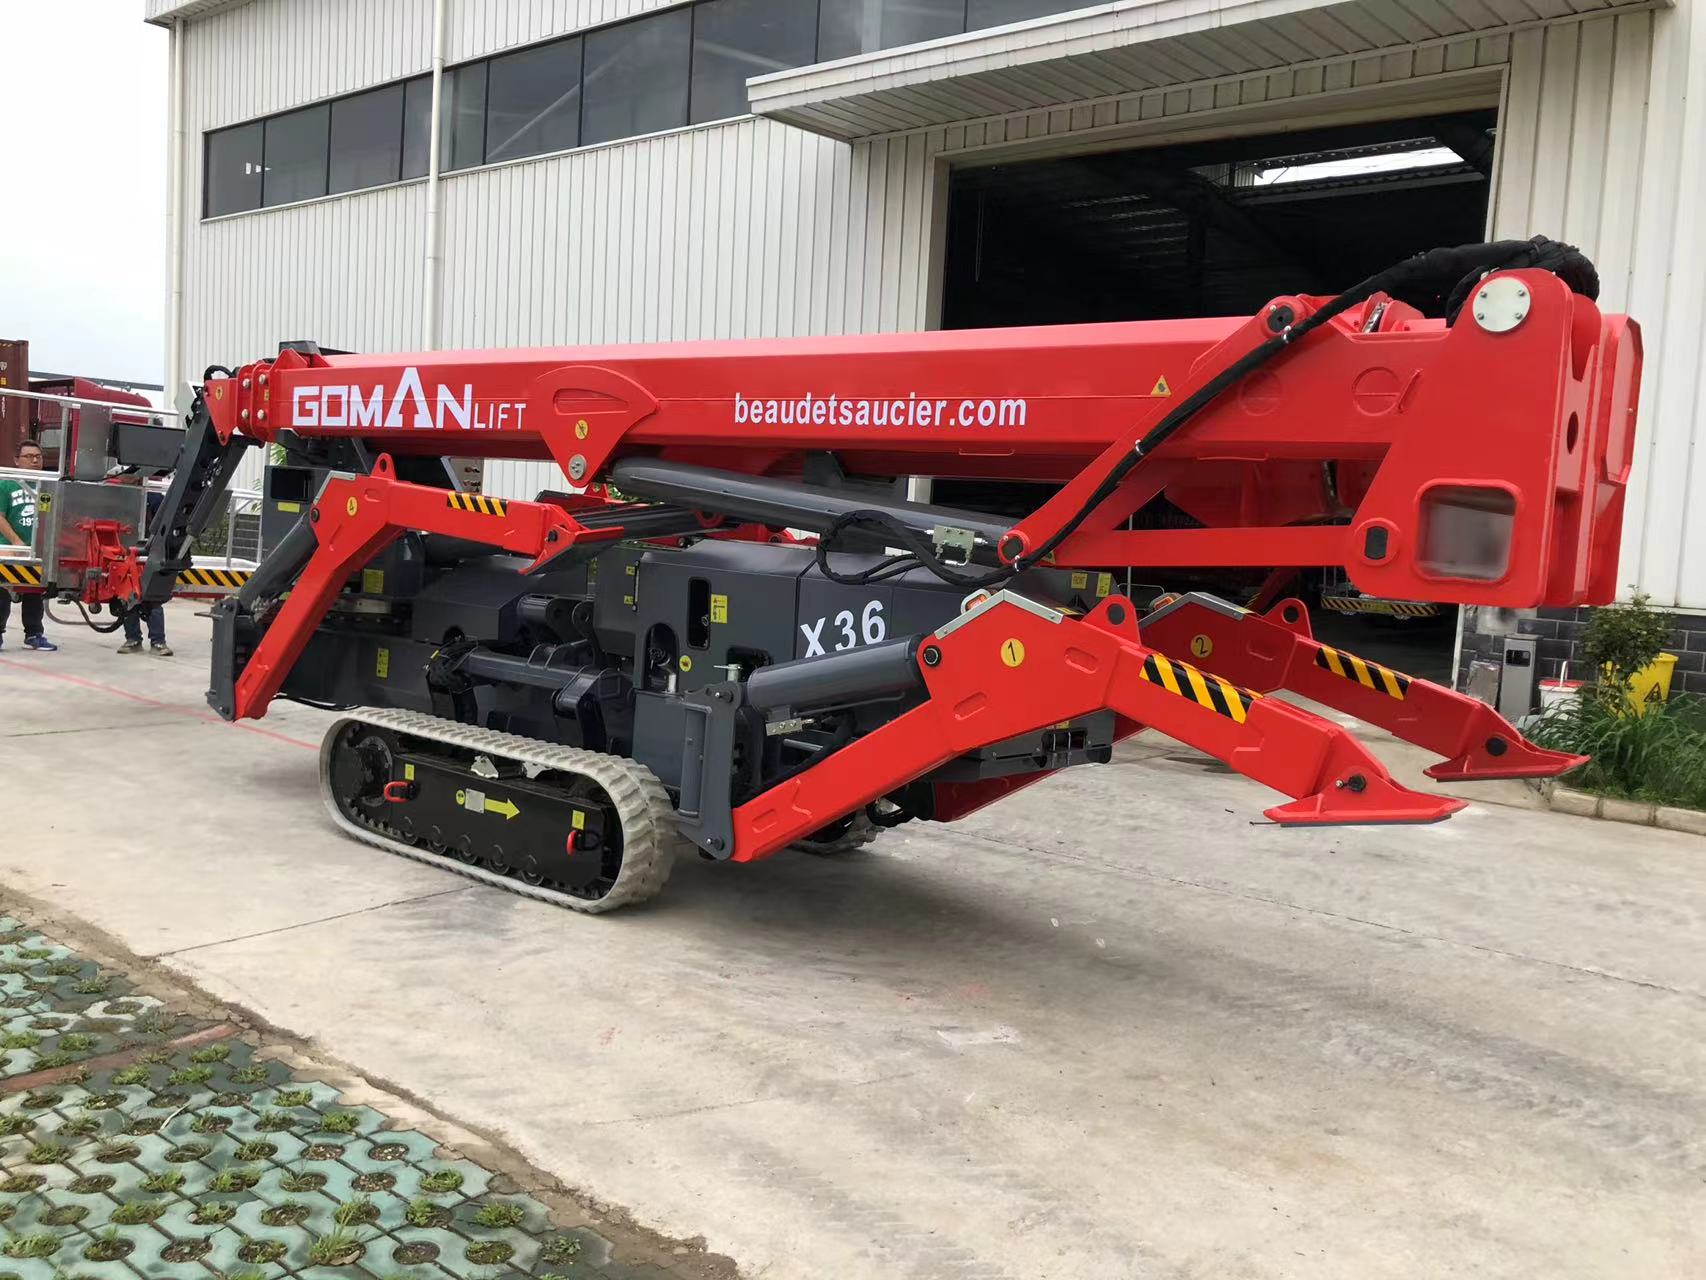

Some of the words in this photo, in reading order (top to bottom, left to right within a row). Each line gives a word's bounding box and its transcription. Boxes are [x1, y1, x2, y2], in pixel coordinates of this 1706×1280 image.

[292, 367, 472, 429] GOMAN
[474, 403, 526, 429] LIFT
[735, 392, 1027, 427] beaudetsaucier.com
[800, 600, 886, 658] X36
[1196, 636, 1208, 655] 2
